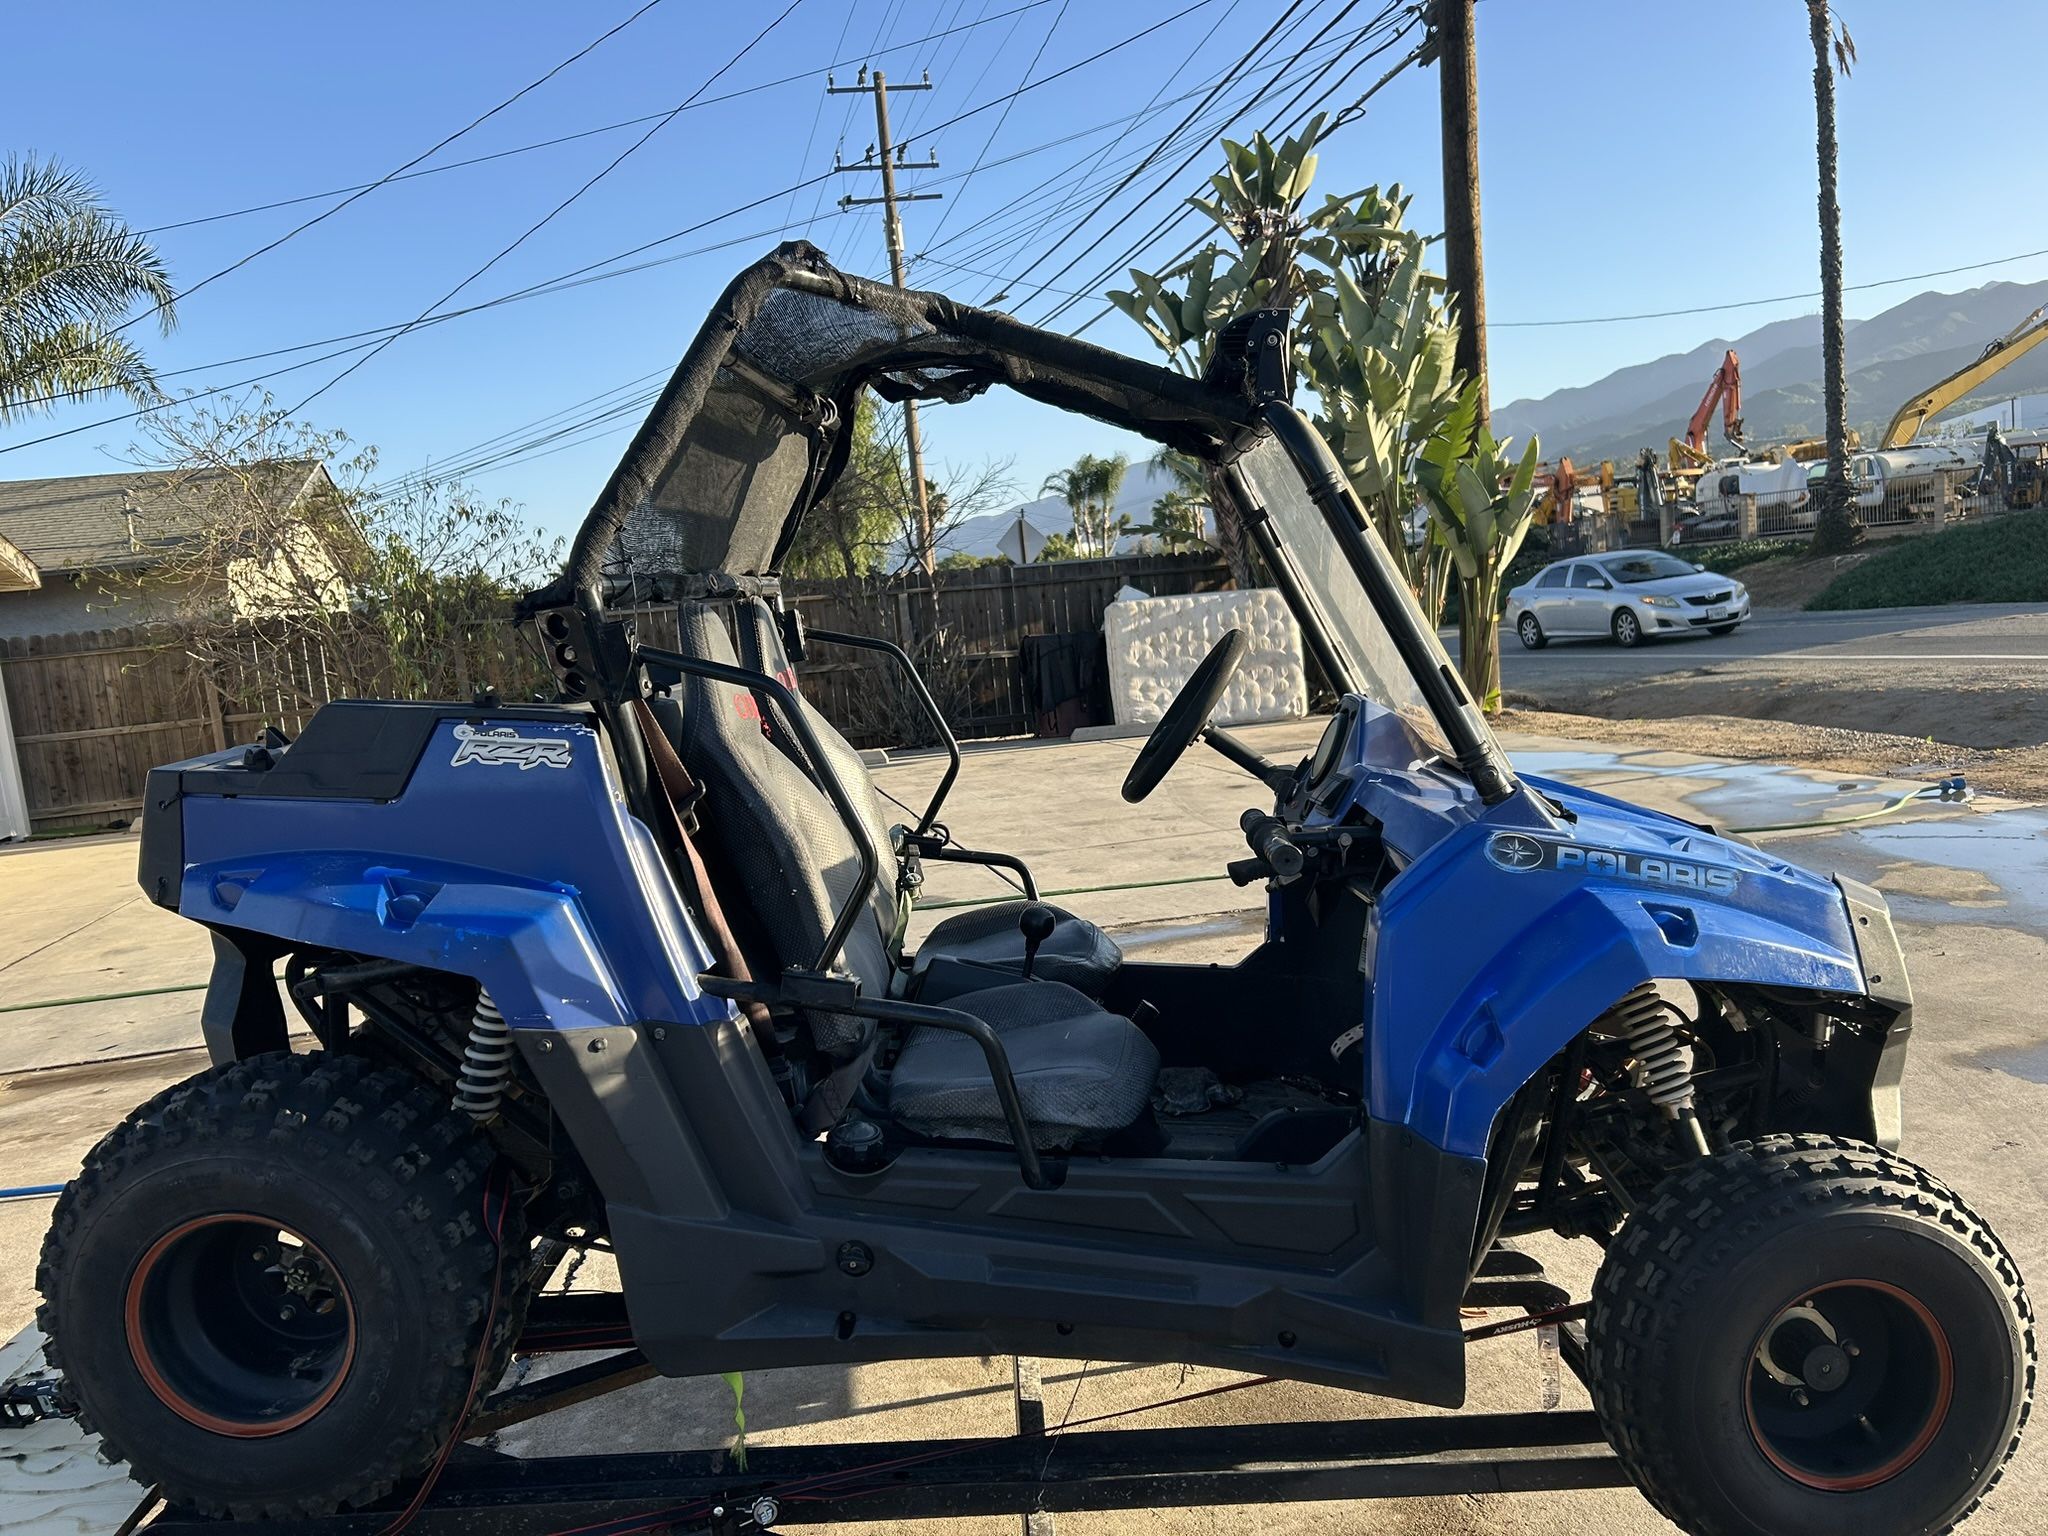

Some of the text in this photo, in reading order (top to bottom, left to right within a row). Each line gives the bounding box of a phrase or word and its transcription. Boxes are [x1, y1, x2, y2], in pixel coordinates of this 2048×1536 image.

[472, 730, 517, 739] POLARIS
[453, 738, 571, 768] RZR
[1556, 846, 1738, 897] POLARIS
[1493, 1320, 1529, 1335] HUSKY
